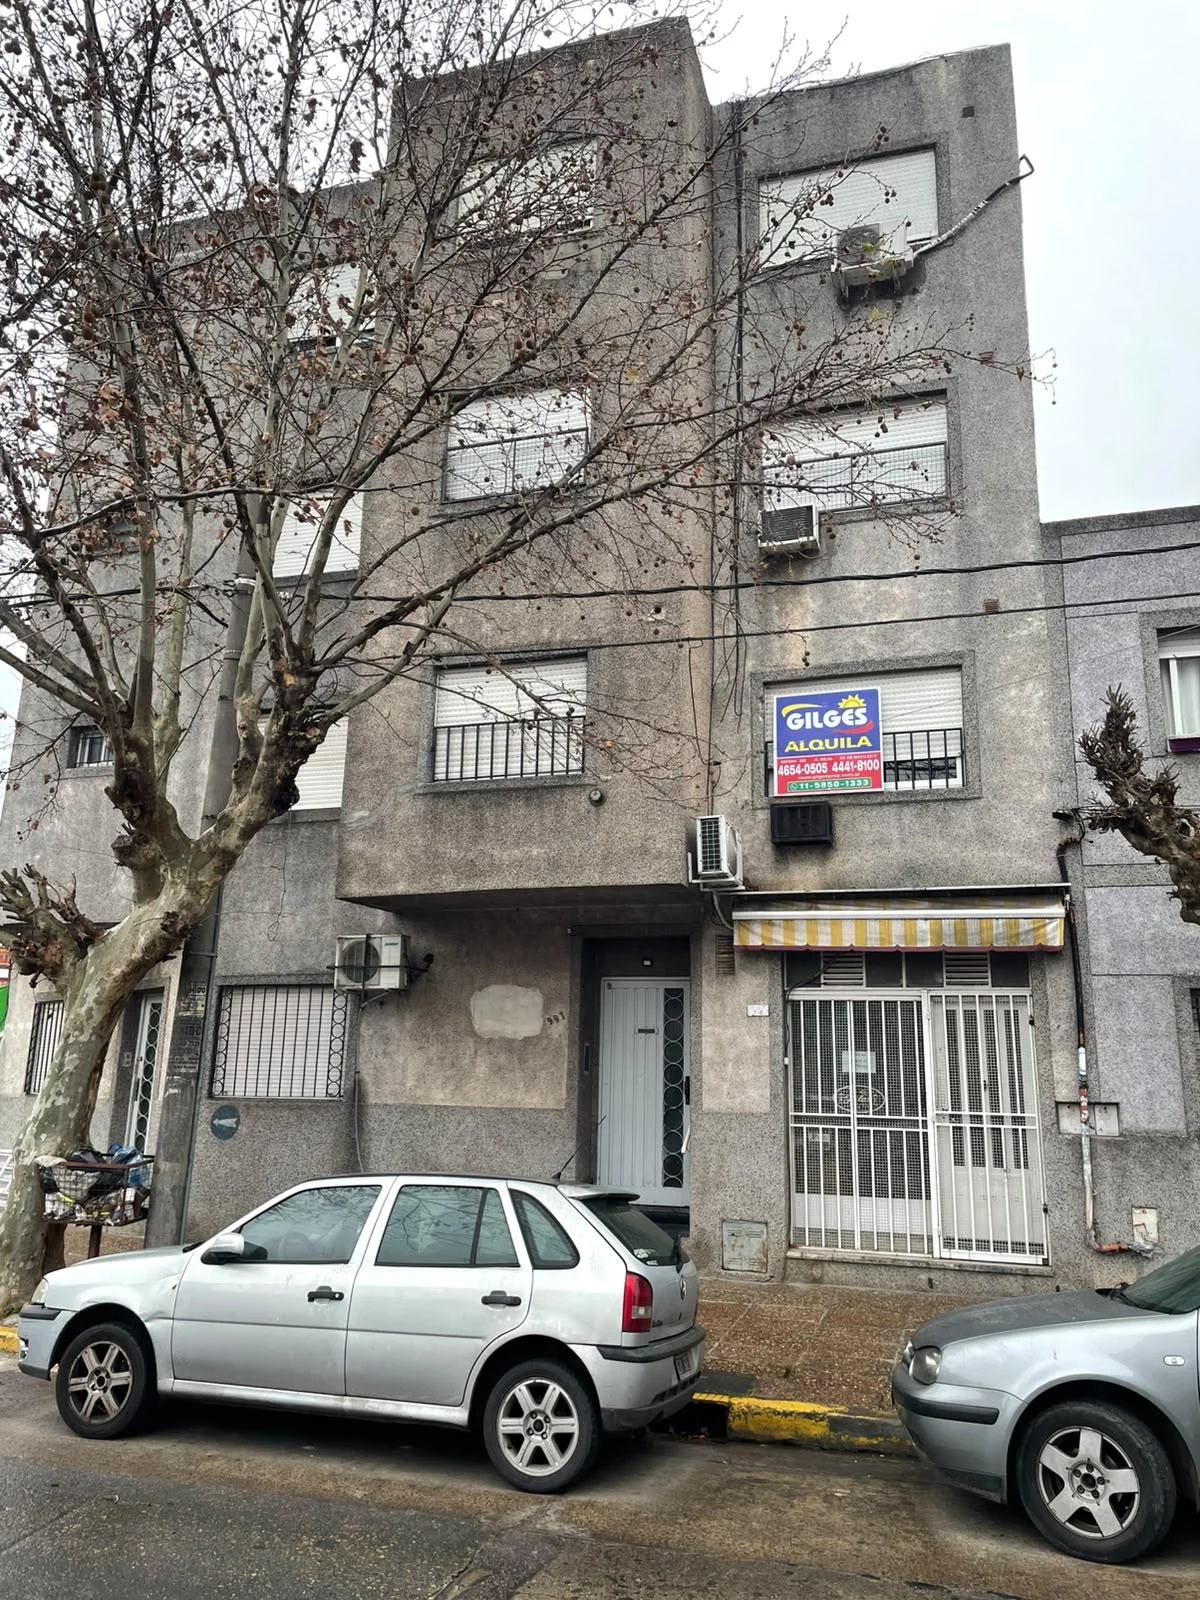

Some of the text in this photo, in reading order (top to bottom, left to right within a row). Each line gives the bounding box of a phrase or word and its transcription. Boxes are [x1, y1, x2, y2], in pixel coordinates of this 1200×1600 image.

[786, 707, 868, 730] GILGES
[784, 736, 872, 752] ALQUILA
[778, 762, 828, 776] 4654-0505
[832, 759, 880, 773] 4441-8100
